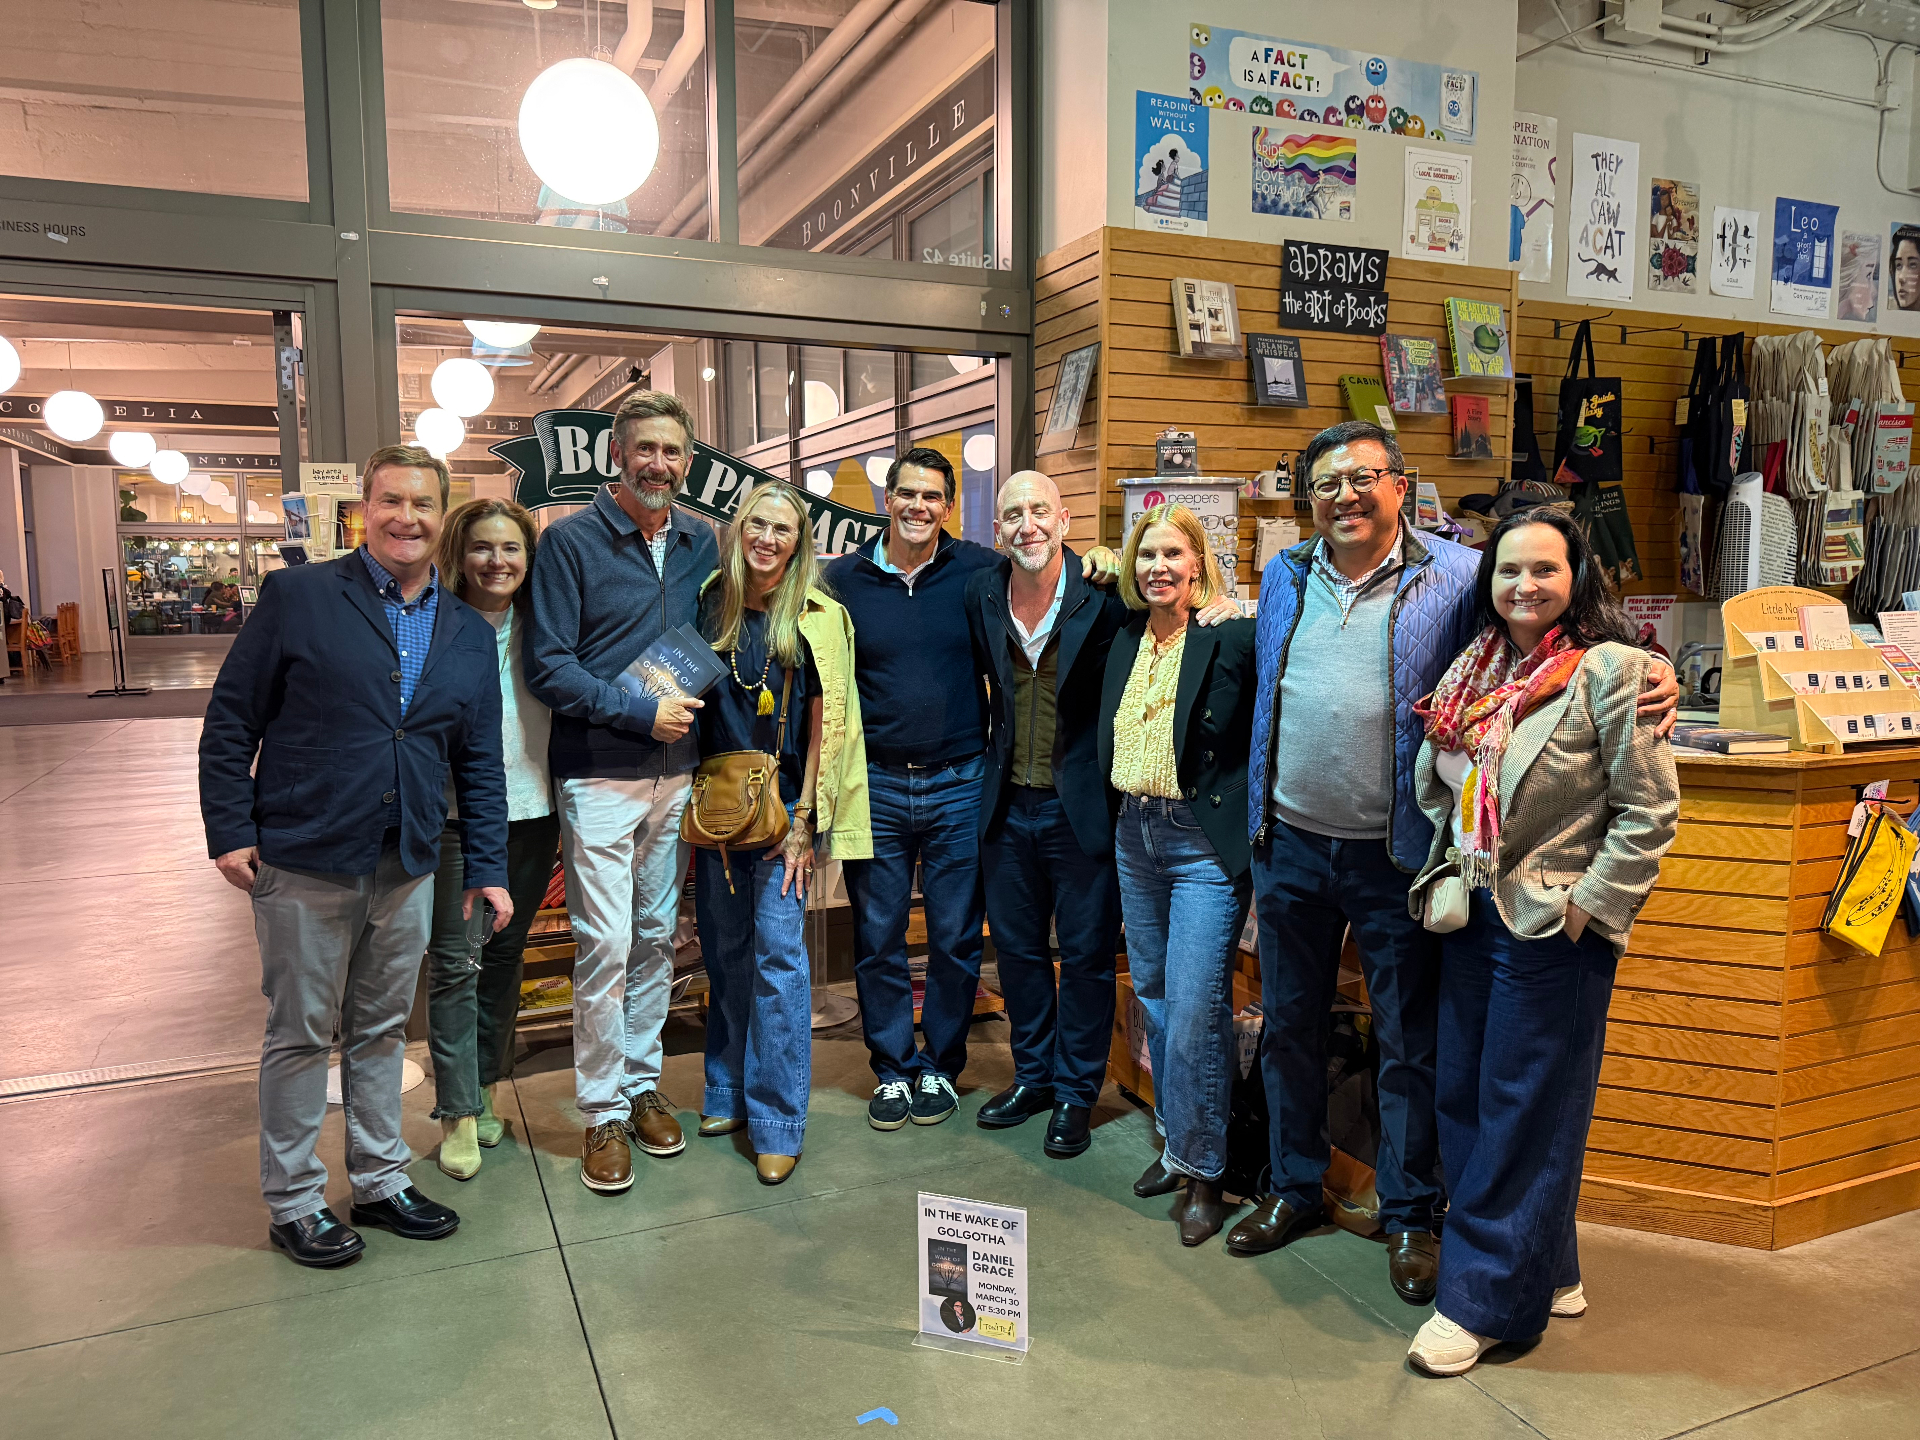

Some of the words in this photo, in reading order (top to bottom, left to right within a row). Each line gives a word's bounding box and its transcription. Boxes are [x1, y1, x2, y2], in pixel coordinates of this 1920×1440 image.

[1251, 50, 1259, 62] A
[1264, 48, 1308, 70] FACT
[1244, 68, 1254, 82] IS
[1258, 72, 1266, 84] A
[1270, 70, 1320, 92] FACT!
[1150, 98, 1196, 113] READING
[1158, 110, 1188, 119] WITHOUT
[1150, 116, 1196, 133] WALLS
[1513, 122, 1538, 134] PIRE
[1256, 144, 1284, 157] PRIDE
[1256, 156, 1284, 170] HOPE
[1591, 151, 1623, 175] THEY
[803, 99, 965, 246] BOONVILLE
[1256, 170, 1284, 183] LOVE
[1256, 182, 1306, 198] EQUALITY
[1595, 172, 1616, 198] ALL
[1589, 198, 1621, 228] SAW
[1790, 206, 1819, 232] Leo
[44, 224, 86, 237] HOURS
[1579, 224, 1590, 248] A
[1592, 227, 1626, 259] CAT
[1282, 290, 1302, 314] the
[1333, 300, 1346, 318] of
[1344, 292, 1387, 328] Books
[1456, 300, 1468, 312] THE
[1468, 302, 1480, 313] ART
[1480, 304, 1488, 314] OF
[1488, 305, 1500, 316] THE
[1256, 348, 1298, 358] WHISPERS
[1258, 342, 1288, 350] ISLAND
[1348, 376, 1380, 386] CABIN
[1590, 392, 1616, 408] Guide
[1584, 406, 1604, 418] laxy
[1878, 417, 1906, 426] ancisco
[312, 468, 324, 476] bay
[1168, 494, 1220, 505] peepers
[1602, 491, 1618, 500] FOR
[1762, 602, 1783, 614] Little
[672, 648, 684, 659] IN
[685, 658, 700, 674] THE
[658, 653, 682, 677] WAKE
[680, 676, 694, 688] OF
[924, 1208, 936, 1218] IN
[938, 1210, 962, 1222] THE
[964, 1214, 999, 1228] WAKE
[1001, 1220, 1018, 1230] OF
[938, 1226, 1006, 1246] GOLGOTHA
[972, 1250, 1015, 1267] DANIEL
[932, 1262, 964, 1272] GOLGOTHA
[972, 1262, 1014, 1278] GRACE
[978, 1282, 1017, 1296] MONDAY,
[976, 1292, 1006, 1304] MARCH
[1008, 1298, 1020, 1307] 30
[988, 1306, 1006, 1316] 5:30
[1008, 1310, 1021, 1318] PM
